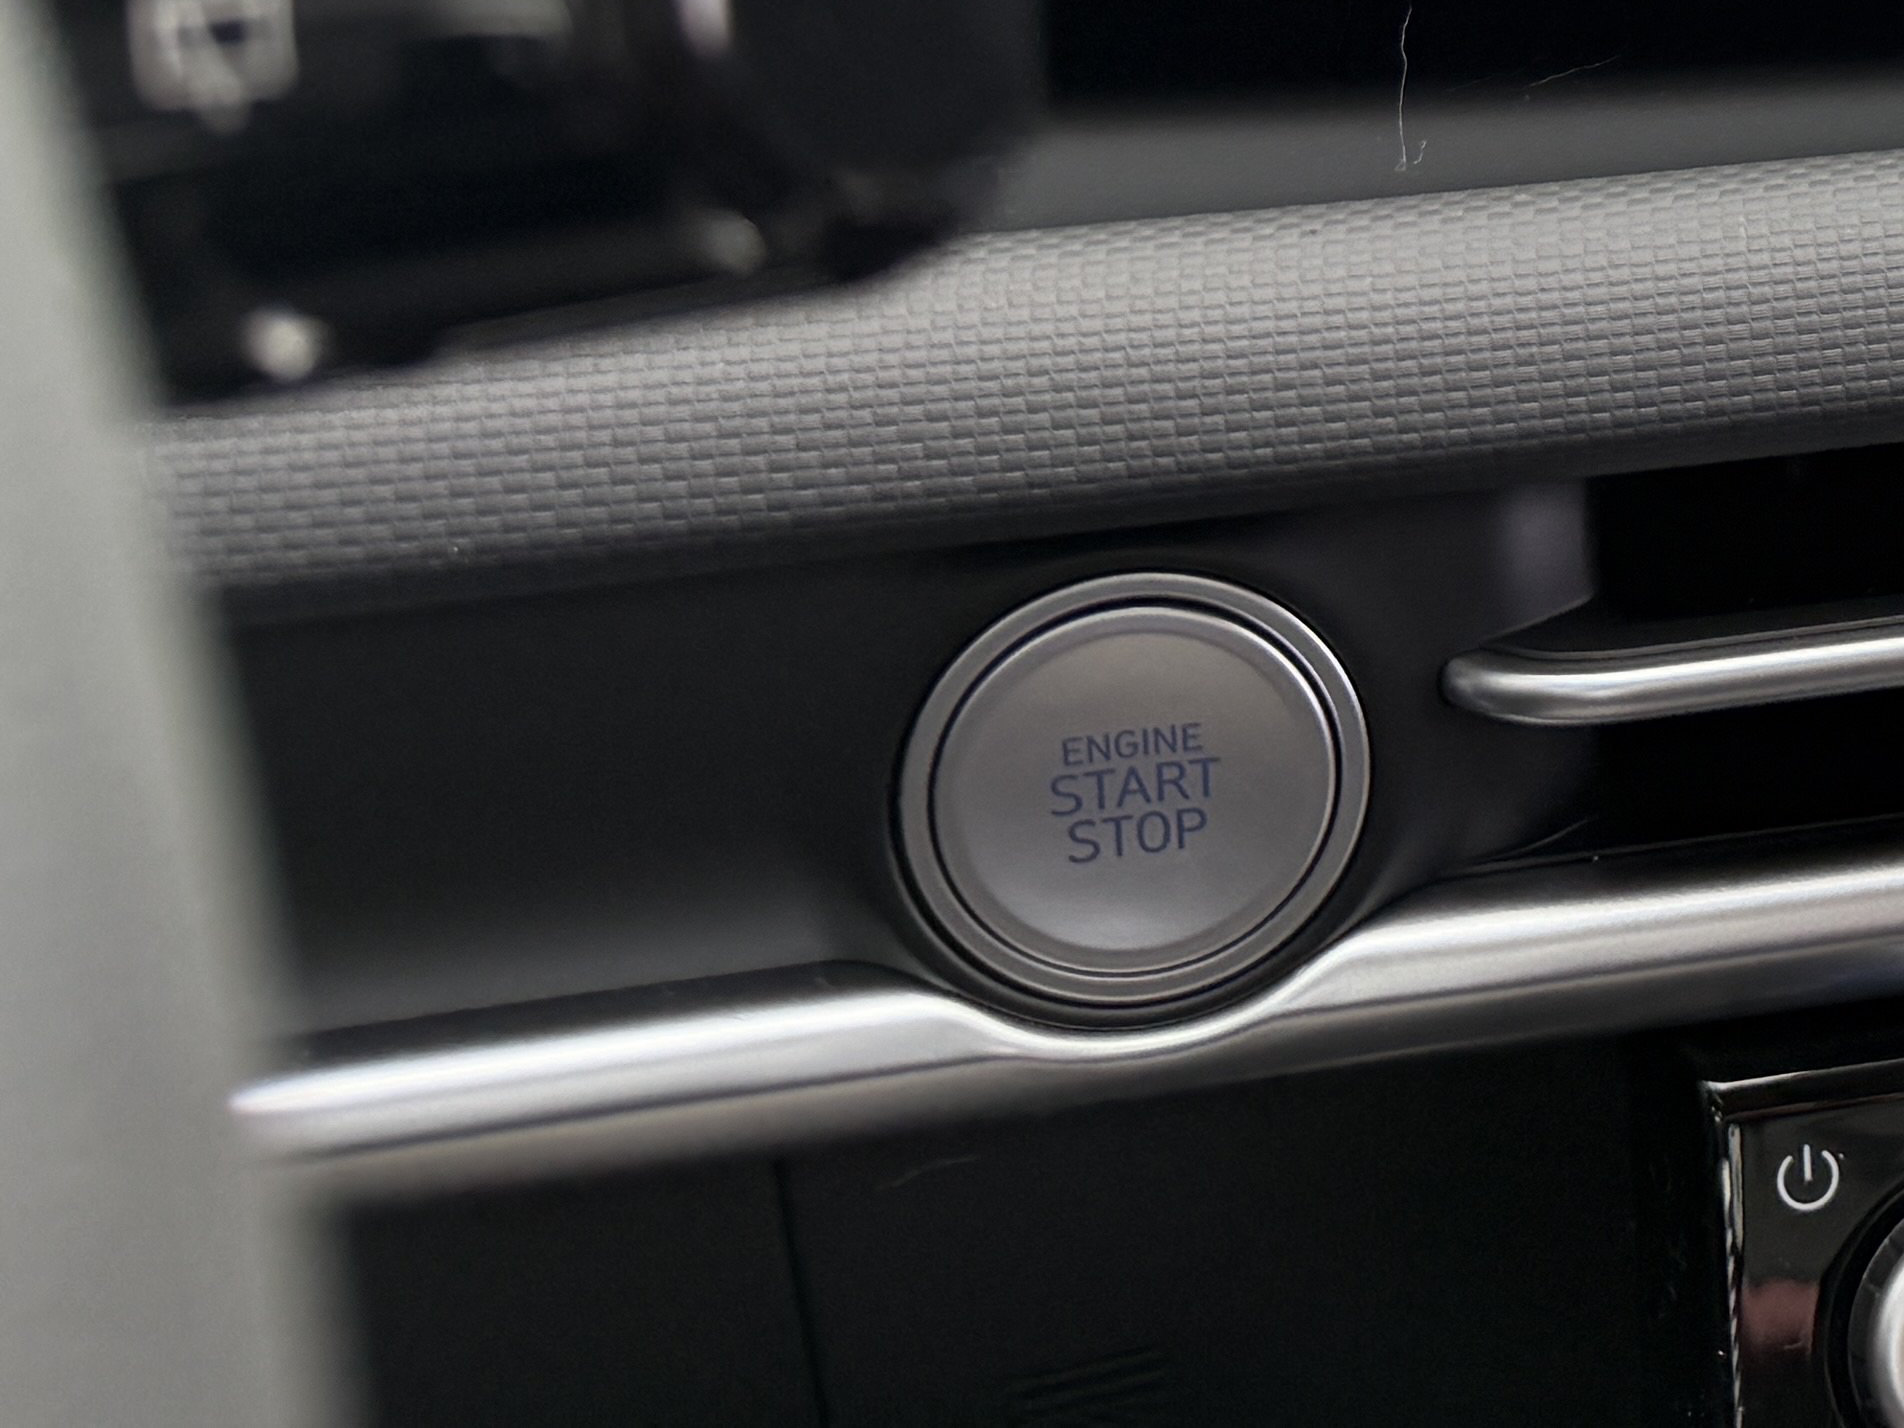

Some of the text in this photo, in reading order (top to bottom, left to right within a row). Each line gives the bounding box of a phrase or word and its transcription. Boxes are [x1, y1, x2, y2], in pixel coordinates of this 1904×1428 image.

[1062, 723, 1203, 766] ENGINE
[1051, 756, 1220, 816] START
[1068, 807, 1207, 864] STOP
